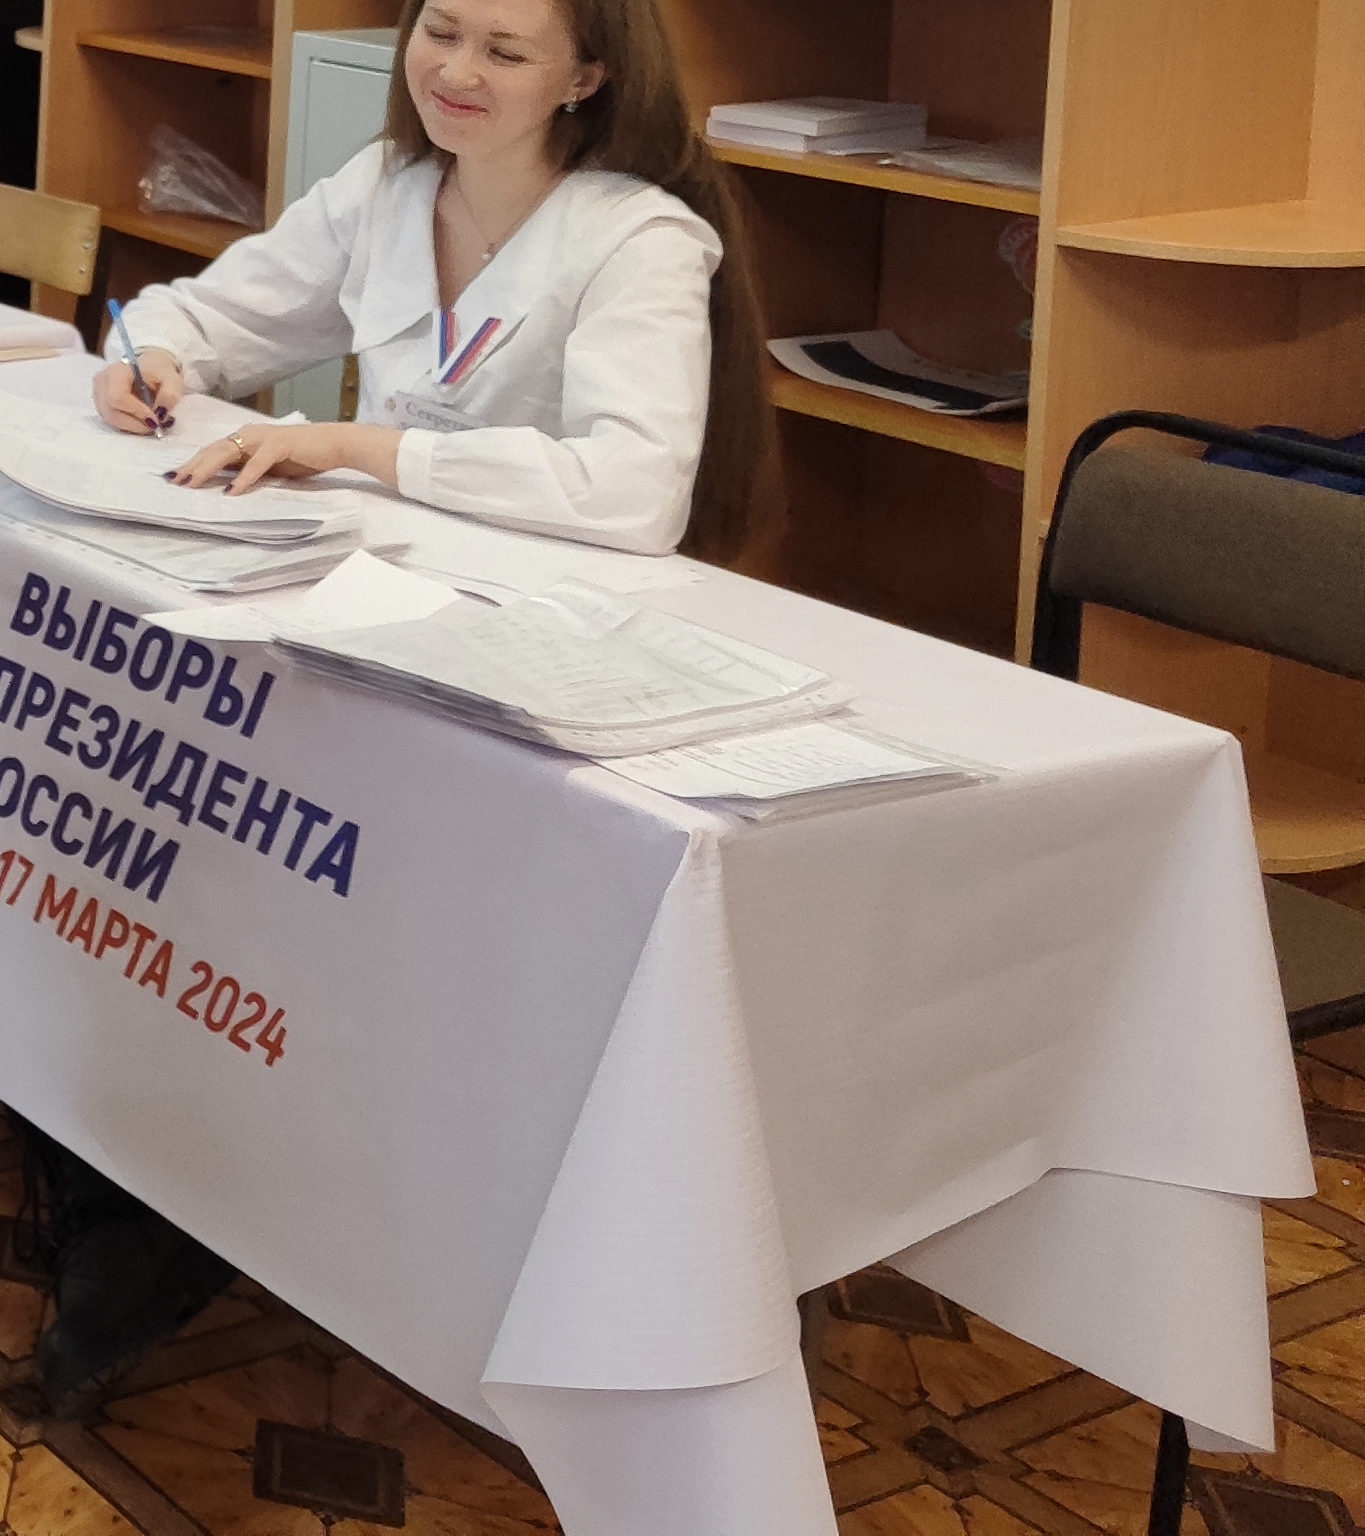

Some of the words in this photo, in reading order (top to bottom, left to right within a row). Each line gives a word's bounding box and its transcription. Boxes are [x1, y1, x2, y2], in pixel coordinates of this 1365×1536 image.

[9, 571, 276, 739] ВЫБОРЫ
[33, 874, 176, 999] МАРТА
[176, 960, 286, 1068] 2024
